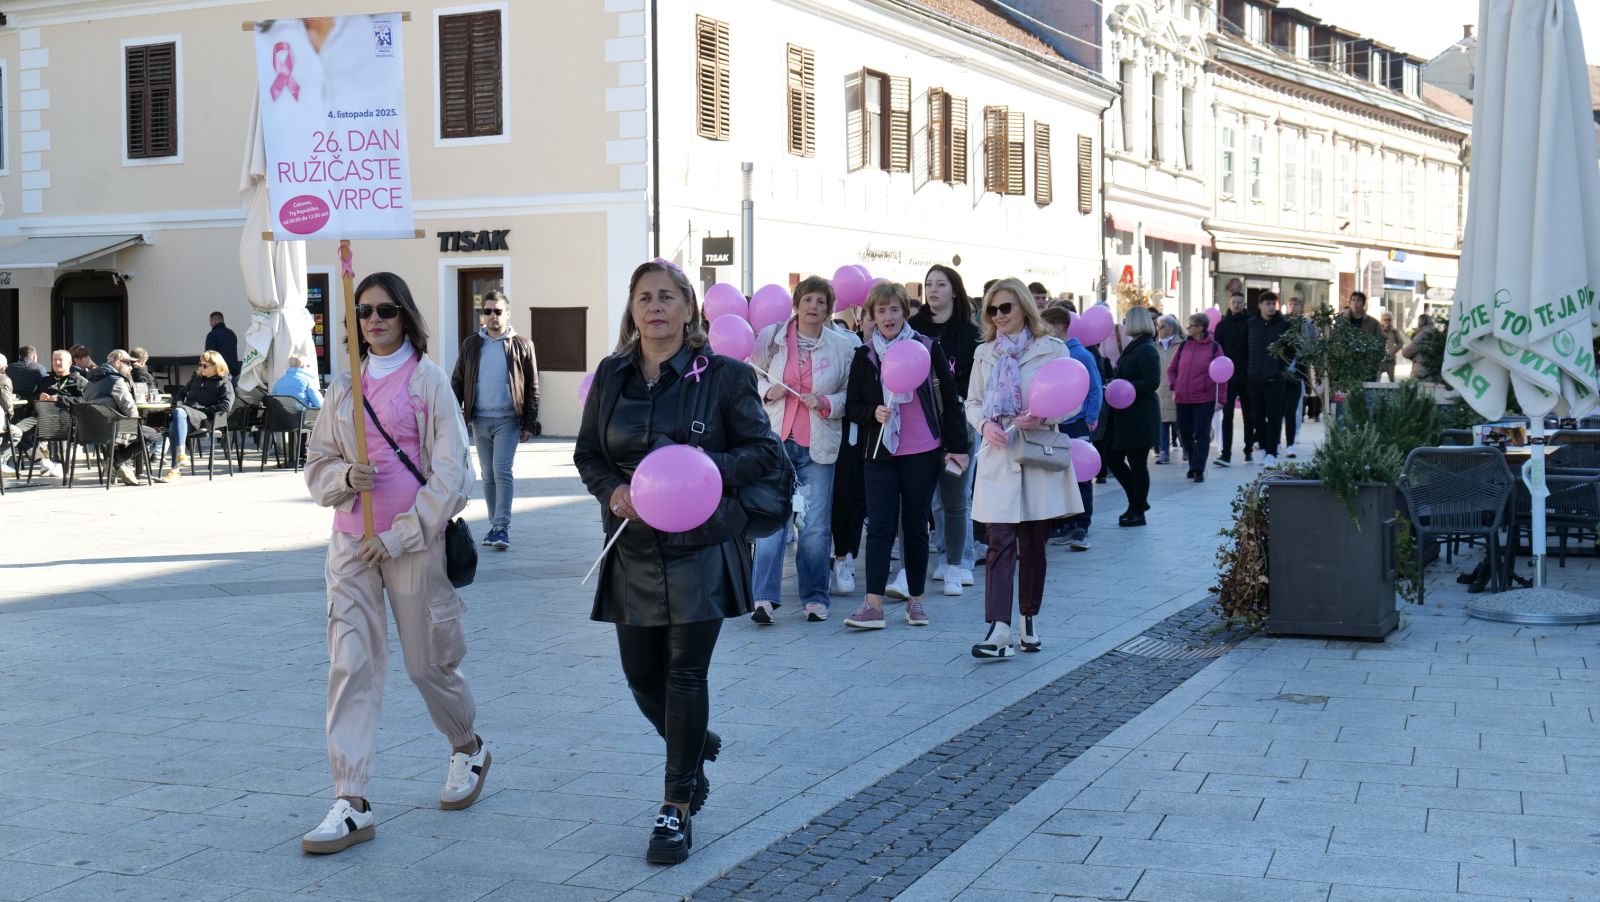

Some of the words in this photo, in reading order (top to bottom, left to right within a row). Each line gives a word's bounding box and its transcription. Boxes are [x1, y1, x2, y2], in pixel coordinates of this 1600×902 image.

[327, 110, 336, 119] 4.
[336, 109, 374, 120] listopada
[375, 108, 398, 118] 2025.
[312, 130, 343, 153] 26.
[348, 128, 400, 152] DAN
[277, 154, 402, 183] RUŽIČASTE
[328, 187, 403, 210] VRPCE
[437, 229, 511, 253] TISAK
[705, 254, 729, 262] TISAK
[1534, 303, 1556, 327] TE
[1557, 294, 1578, 319] JA
